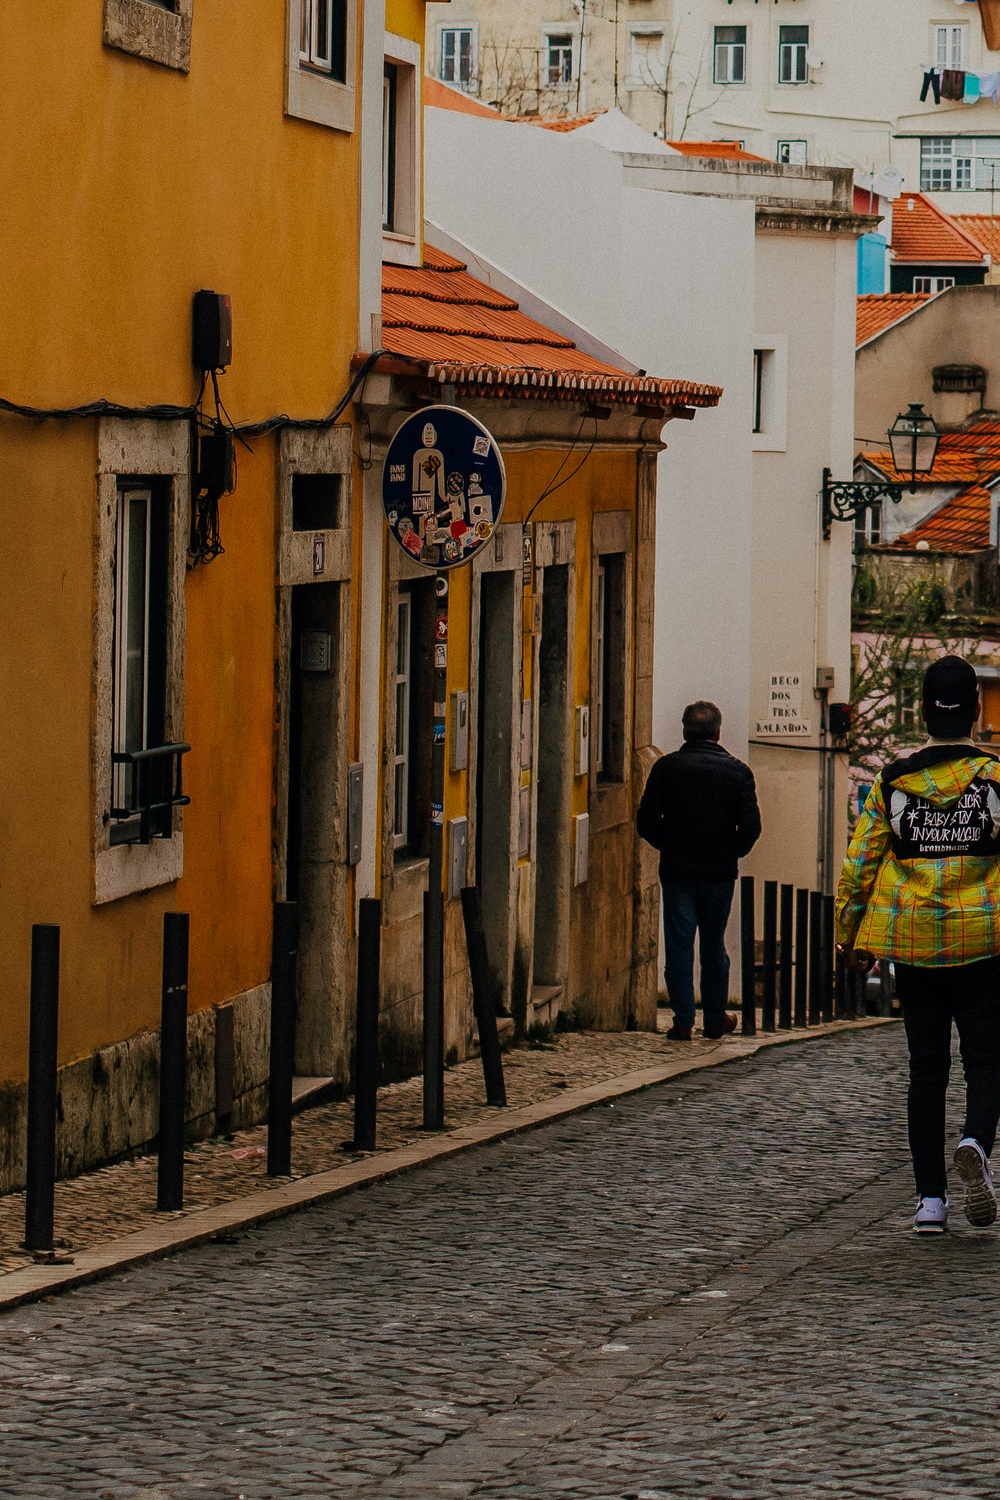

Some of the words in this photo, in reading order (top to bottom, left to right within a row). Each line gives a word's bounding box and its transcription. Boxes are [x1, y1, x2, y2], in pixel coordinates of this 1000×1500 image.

[771, 676, 799, 686] BECO
[771, 691, 791, 701] DOS
[923, 811, 950, 827] BABY
[949, 810, 973, 826] STAY
[951, 826, 981, 843] MAGIC
